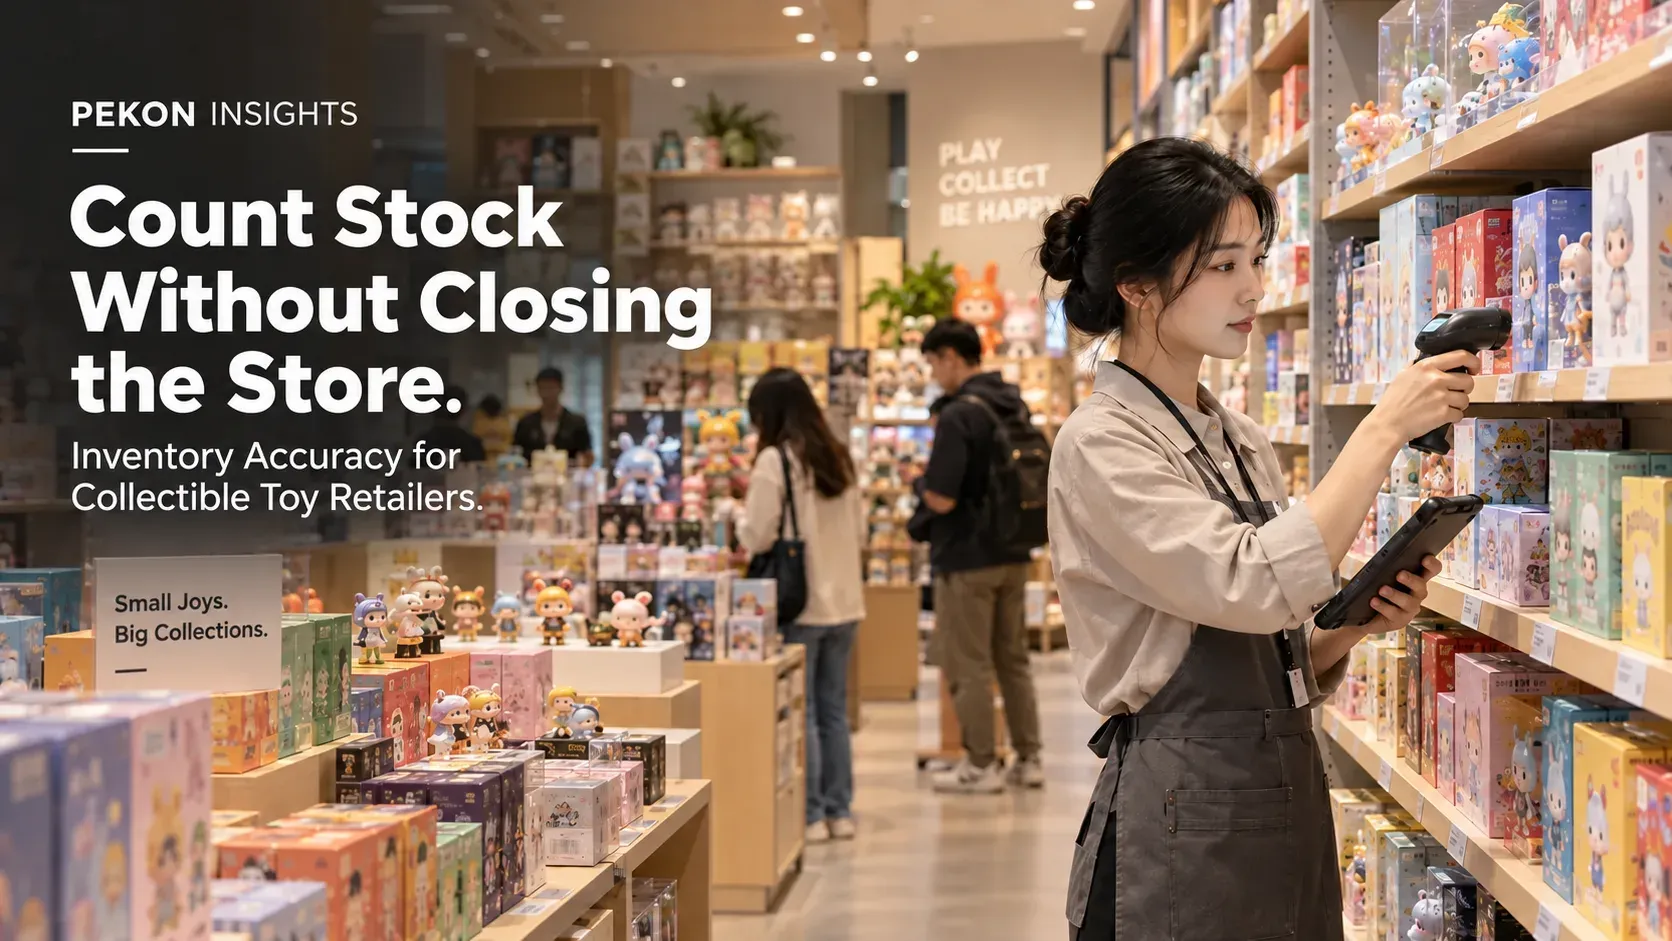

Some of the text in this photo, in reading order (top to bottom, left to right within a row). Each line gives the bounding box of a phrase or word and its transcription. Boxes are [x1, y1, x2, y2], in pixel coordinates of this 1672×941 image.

[938, 137, 1003, 166] PLAY
[938, 162, 1051, 197] COLLECT
[938, 202, 974, 228] BE
[114, 592, 229, 615] Small Joys.
[114, 620, 268, 648] Big Collections.
